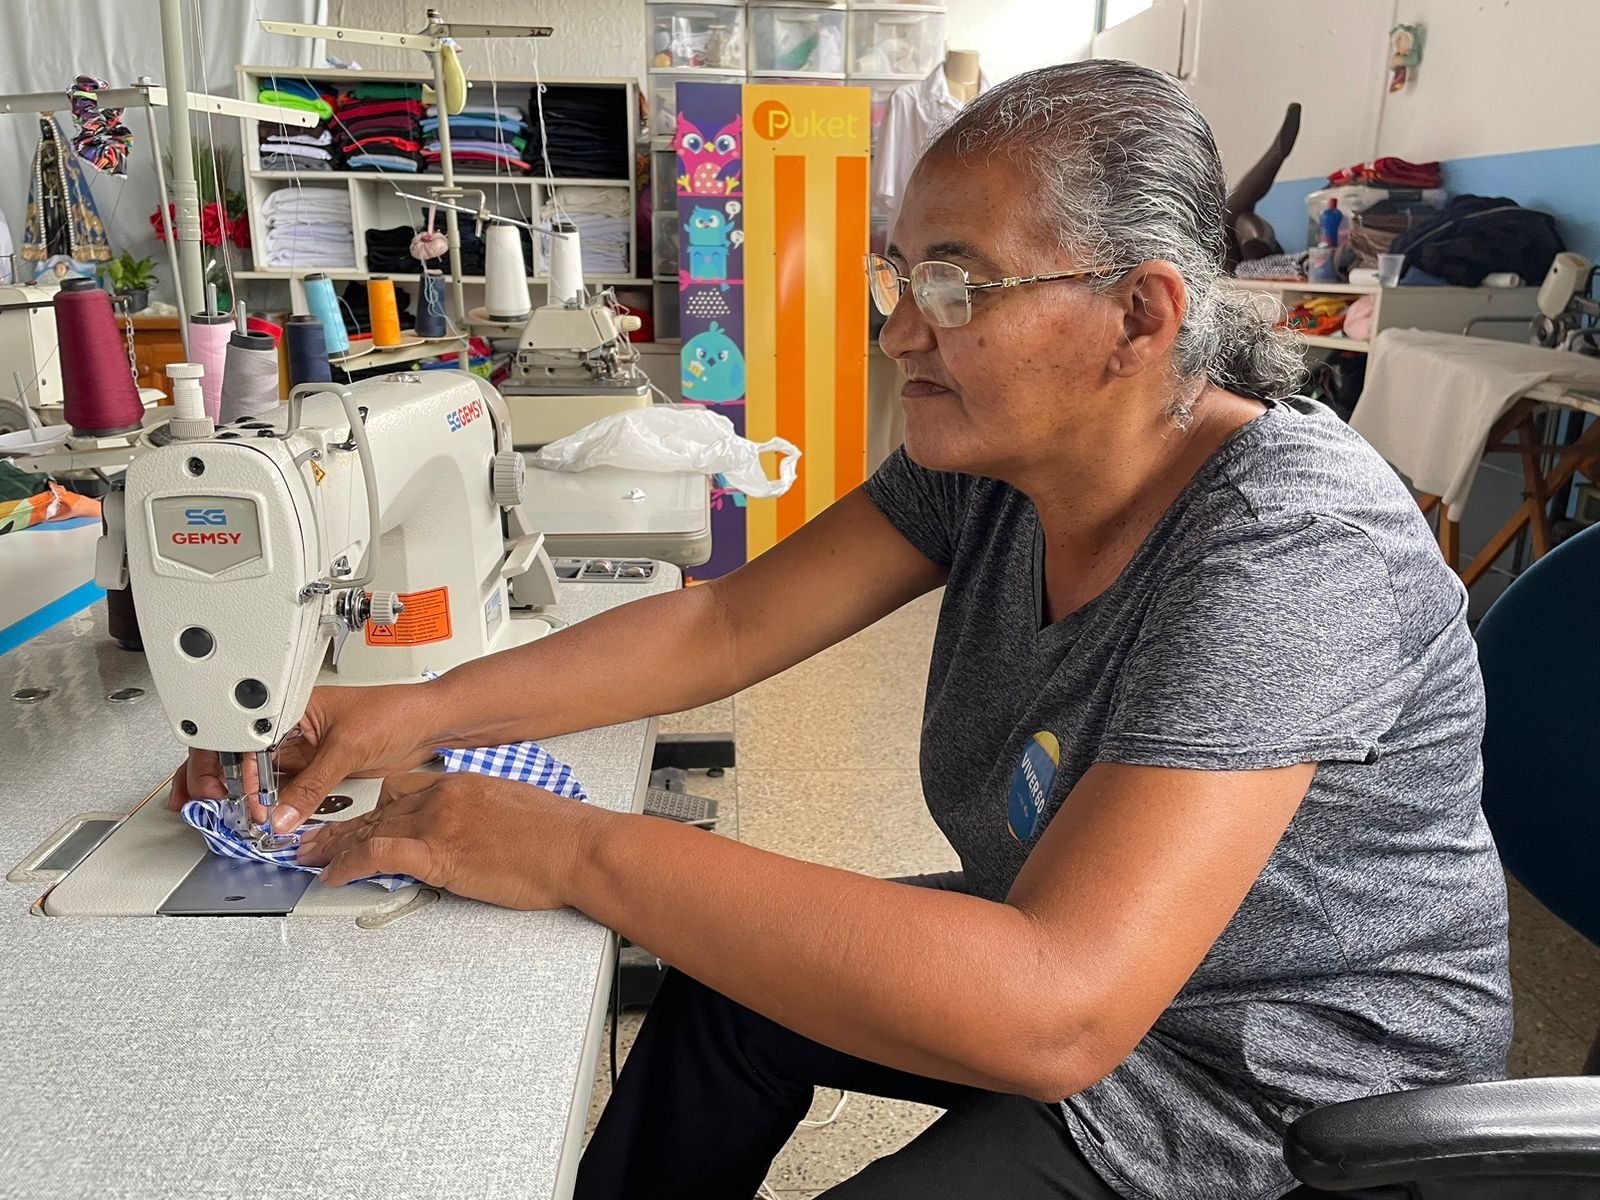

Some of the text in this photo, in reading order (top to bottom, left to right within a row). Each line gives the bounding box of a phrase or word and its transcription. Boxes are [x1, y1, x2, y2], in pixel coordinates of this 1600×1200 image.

[768, 109, 859, 138] Puket
[185, 509, 227, 525] SG
[172, 533, 241, 545] GEMSY
